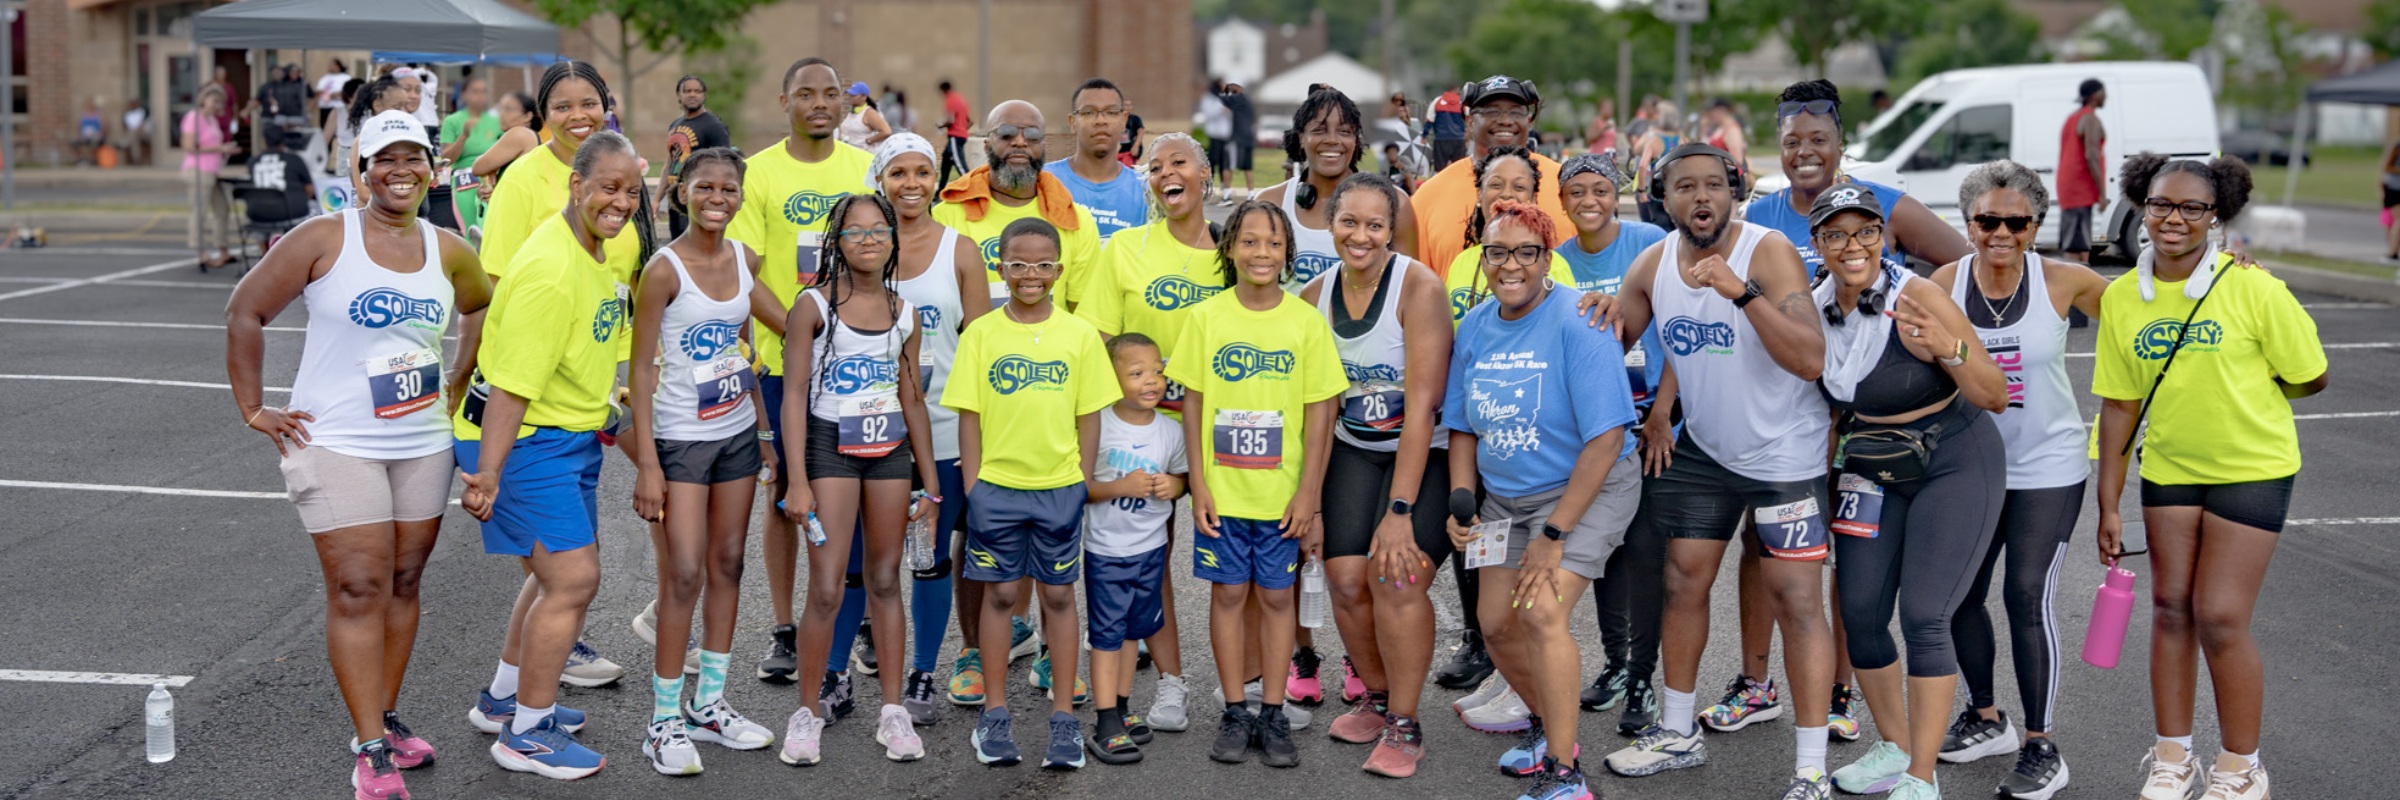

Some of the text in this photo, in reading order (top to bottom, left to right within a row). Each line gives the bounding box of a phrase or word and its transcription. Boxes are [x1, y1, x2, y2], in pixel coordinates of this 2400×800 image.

[1830, 188, 1860, 203] 20
[796, 196, 837, 226] SOLE
[1098, 217, 1110, 225] 5K
[1111, 218, 1132, 228] Race
[1595, 275, 1621, 287] Annual
[1155, 280, 1221, 311] SOLE
[364, 294, 442, 329] SOLELY
[692, 326, 739, 361] SOLE
[1672, 323, 1730, 356] SOLELY
[1982, 336, 2020, 347] LACK GIRLS
[1223, 349, 1290, 382] SOLELY
[1492, 362, 1514, 370] Akron
[1514, 361, 1525, 369] 5K
[1508, 351, 1534, 360] Annual
[394, 370, 421, 401] 30
[717, 374, 742, 404] 29
[999, 361, 1064, 395] SOLELY
[1362, 394, 1388, 421] 26
[1477, 398, 1520, 422] Akron
[862, 415, 888, 443] 92
[1228, 428, 1268, 455] 135
[1836, 491, 1859, 520] 73
[1781, 520, 1810, 548] 72
